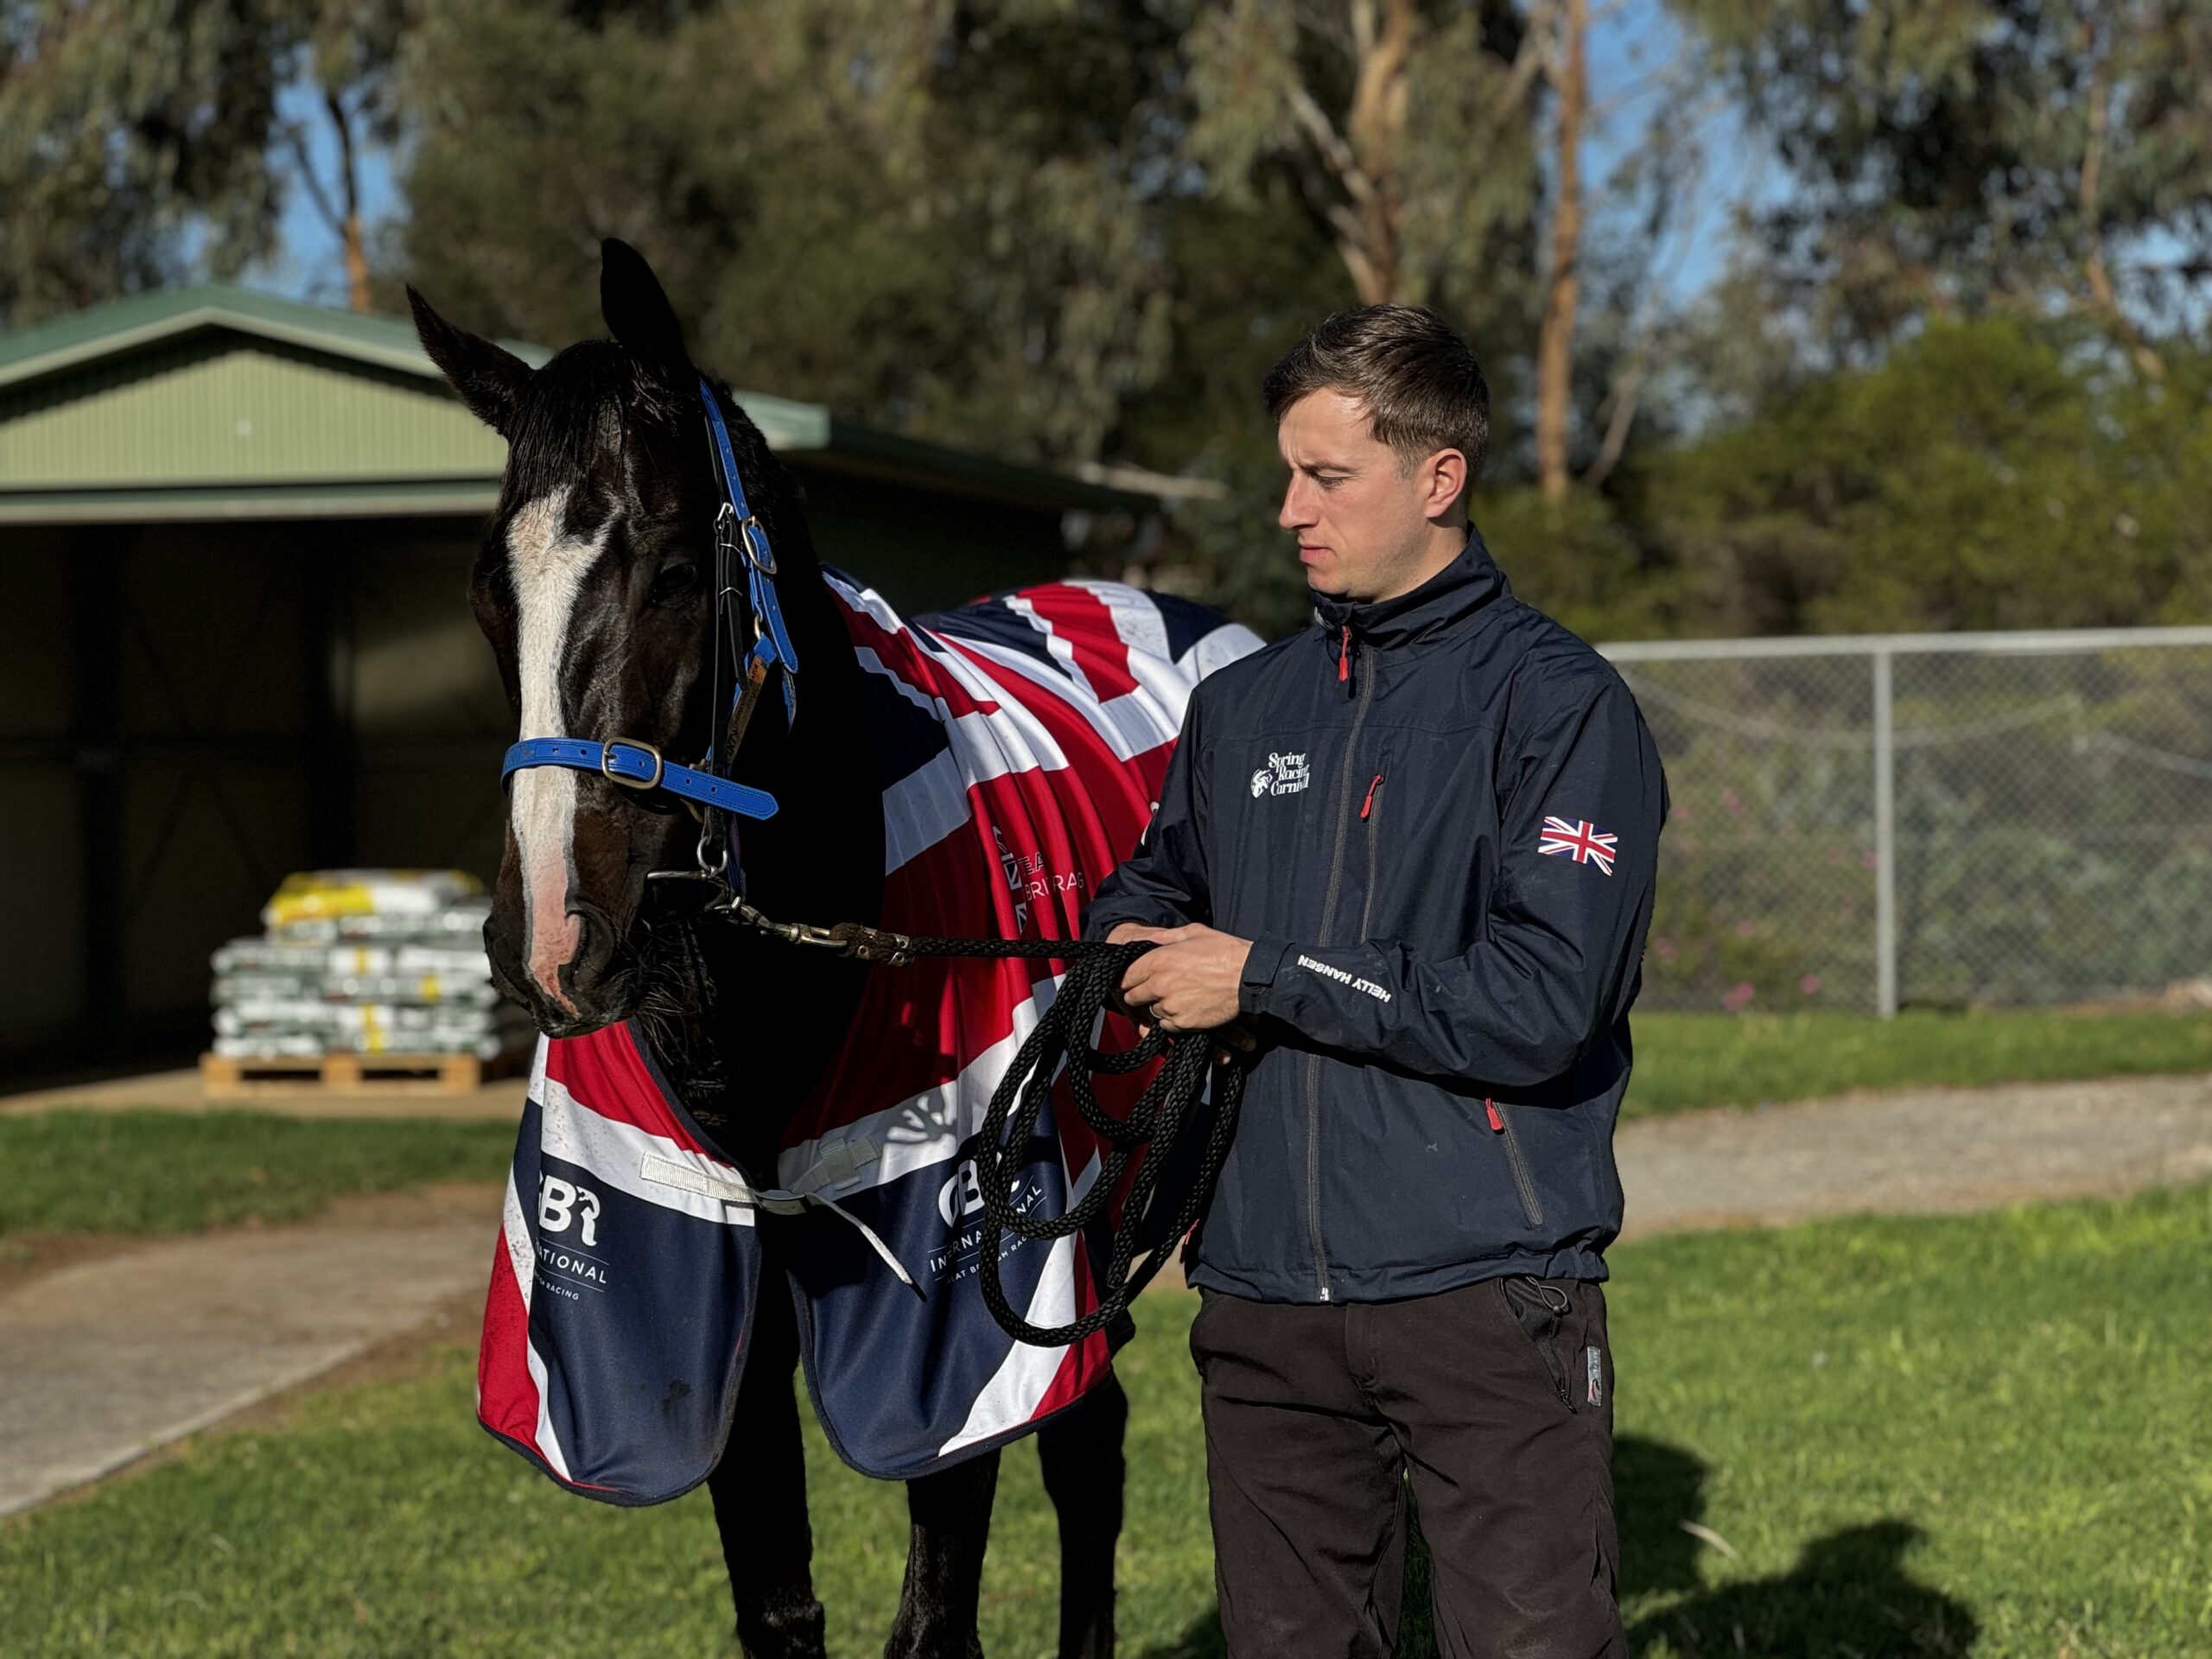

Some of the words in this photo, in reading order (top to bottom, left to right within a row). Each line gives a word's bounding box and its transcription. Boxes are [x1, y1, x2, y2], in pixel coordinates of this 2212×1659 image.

[1268, 751, 1306, 773] Spring
[1297, 954, 1353, 985] HANSEN
[1351, 977, 1393, 1003] HELLY
[545, 1281, 581, 1300] RACING
